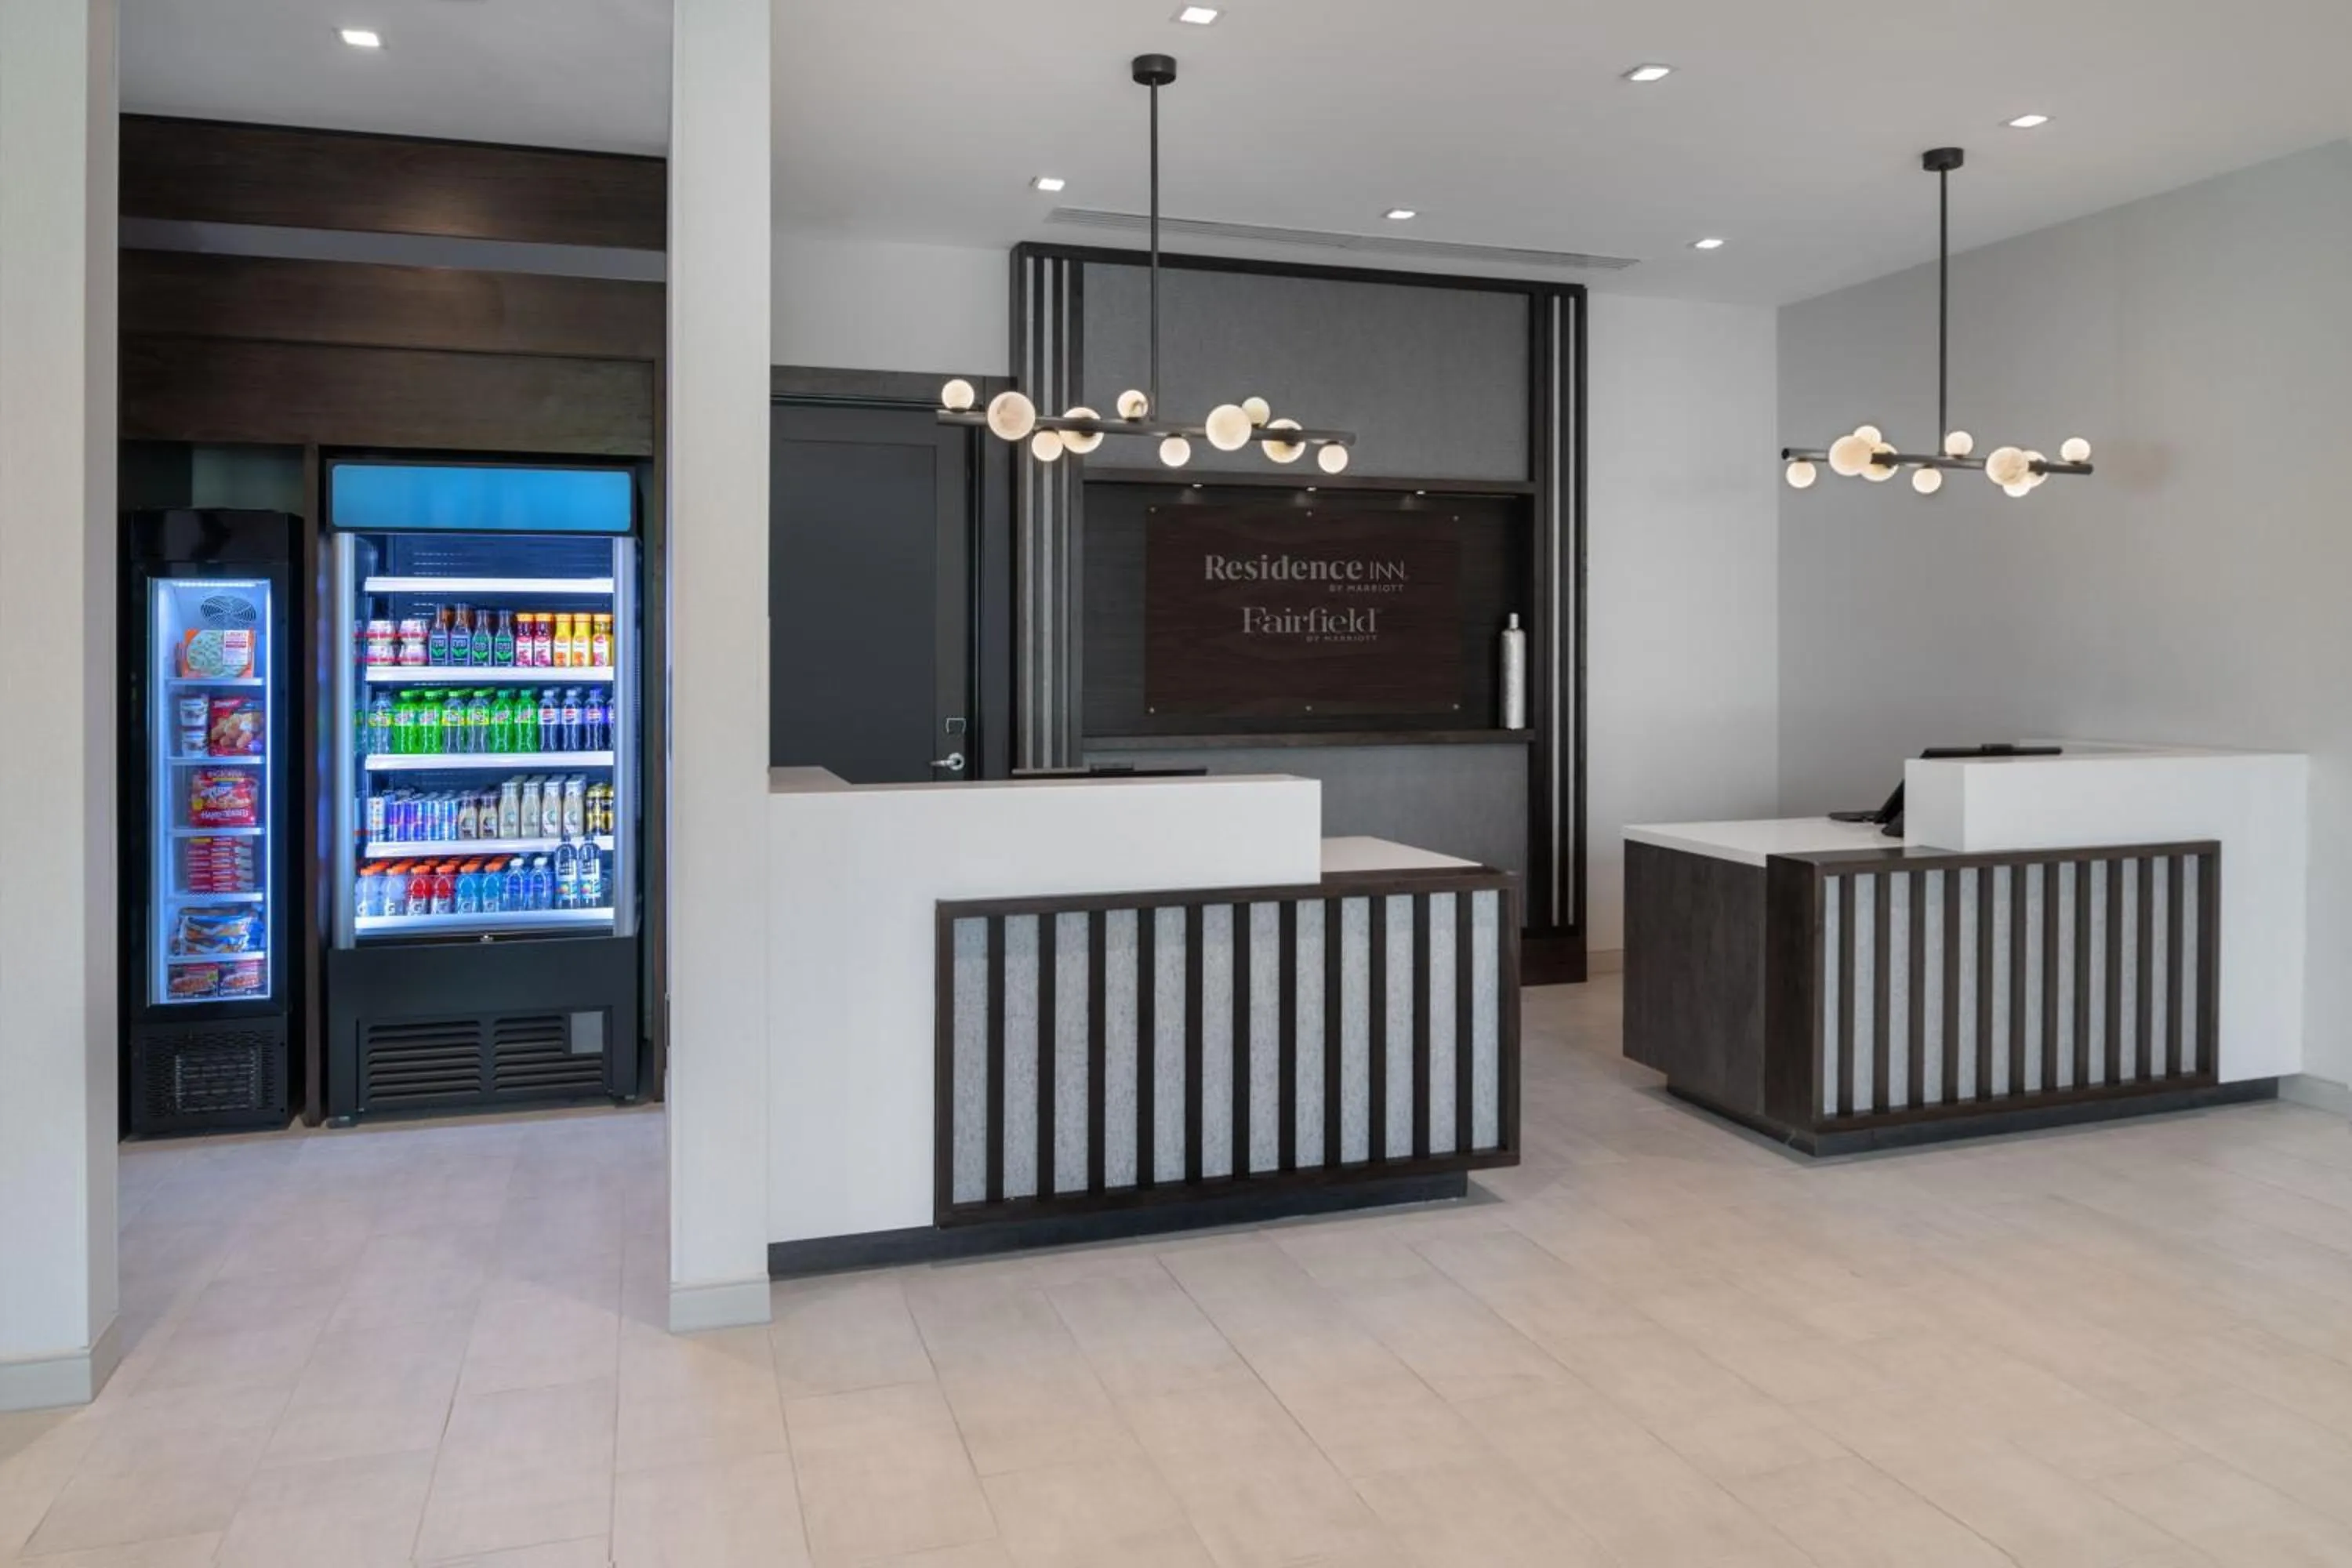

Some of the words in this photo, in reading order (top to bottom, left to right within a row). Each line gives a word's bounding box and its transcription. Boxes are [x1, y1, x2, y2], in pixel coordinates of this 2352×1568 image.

[1204, 554, 1364, 581] Residence
[1370, 560, 1404, 581] INN
[1328, 583, 1344, 593] BY
[1346, 583, 1404, 593] MARRIOTT
[1240, 606, 1377, 633] Fairfield
[1323, 634, 1377, 643] MARRIOTT
